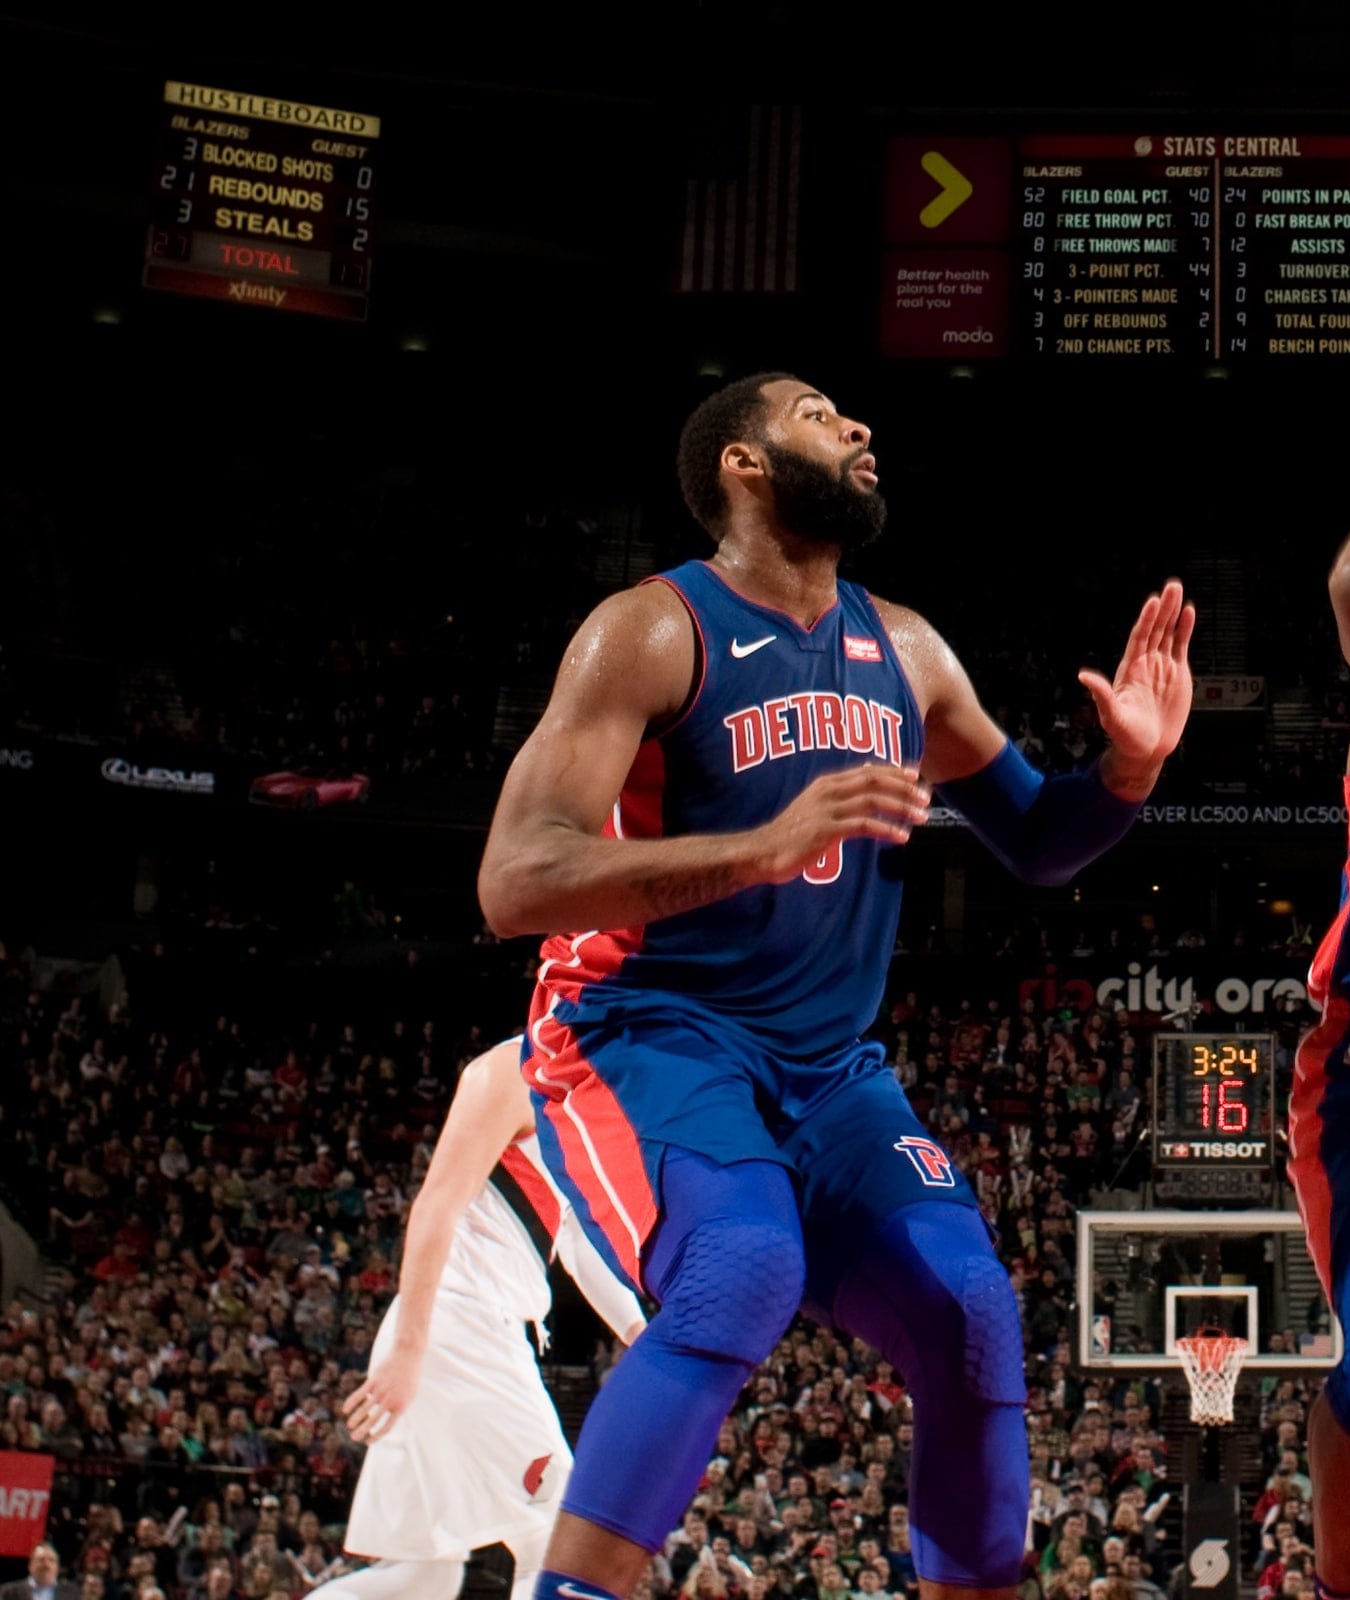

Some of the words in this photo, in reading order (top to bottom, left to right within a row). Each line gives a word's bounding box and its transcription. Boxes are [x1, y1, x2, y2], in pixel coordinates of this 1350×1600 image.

[180, 86, 366, 133] HUSTLEBOARD
[170, 114, 250, 141] BLAZERS
[311, 138, 369, 160] GUEST
[1163, 136, 1216, 157] STATS
[1224, 136, 1302, 157] CENTRAL
[183, 136, 198, 161] 3
[202, 142, 277, 173] BLOCKED
[281, 155, 334, 183] SHOTS
[356, 166, 372, 190] 0
[1023, 165, 1082, 178] BLAZERS
[1165, 165, 1210, 178] GUEST
[1224, 165, 1283, 178] BLAZERS
[160, 165, 196, 192] 21
[208, 174, 324, 213] REBOUNDS
[345, 197, 369, 221] 15
[1024, 186, 1046, 203] 52
[1061, 188, 1100, 204] FIELD
[1104, 188, 1139, 204] GOAL
[1142, 188, 1172, 204] PCT.
[1189, 187, 1210, 204] 40
[1224, 187, 1246, 203] 24
[1261, 188, 1311, 204] POINTS
[1314, 188, 1329, 204] IN
[177, 199, 192, 224] 3
[215, 207, 314, 242] STEALS
[352, 228, 368, 252] 2
[1023, 211, 1045, 228] 80
[1056, 213, 1091, 229] FREE
[1094, 213, 1143, 229] THROW
[1147, 213, 1176, 229] PCT.
[1190, 212, 1210, 228] 70
[1235, 211, 1246, 228] 0
[1255, 213, 1286, 229] FAST
[1289, 213, 1331, 229] BREAK
[1033, 236, 1045, 252] 8
[1053, 238, 1085, 254] FREE
[1088, 238, 1141, 254] THROWS
[1143, 238, 1179, 254] MADE
[1202, 237, 1210, 252] 7
[1231, 237, 1246, 252] 12
[1291, 238, 1346, 254] ASSISTS
[220, 243, 299, 275] TOTAL
[897, 268, 943, 280] Better
[945, 268, 990, 280] health
[1023, 262, 1044, 278] 30
[1134, 263, 1165, 279] PCT.
[1189, 262, 1210, 278] 44
[1237, 262, 1246, 278] 3
[228, 279, 287, 307] xfinity
[896, 282, 935, 296] plans
[937, 281, 957, 294] for
[960, 282, 983, 294] the
[1033, 288, 1044, 302] 4
[1141, 288, 1179, 304] MADE
[1199, 288, 1210, 302] 4
[1235, 286, 1246, 303] 0
[1264, 288, 1328, 304] CHARGES
[896, 296, 924, 309] real
[926, 298, 951, 311] you
[1033, 312, 1044, 328] 3
[1063, 313, 1090, 328] OFF
[1094, 313, 1168, 328] REBOUNDS
[1199, 312, 1210, 328] 2
[1236, 312, 1246, 327] 9
[1275, 313, 1315, 329] TOTAL
[942, 324, 994, 343] moda
[1034, 337, 1044, 352] 7
[1056, 338, 1083, 354] 2ND
[1087, 338, 1142, 354] CHANCE
[1145, 338, 1175, 354] PTS.
[1231, 337, 1246, 352] 14
[1269, 338, 1315, 354] BENCH
[723, 692, 903, 773] DETROIT
[133, 765, 216, 787] LEXUS
[1190, 806, 1249, 824] LC500
[1252, 806, 1291, 824] AND
[1096, 961, 1194, 1014] city
[1215, 977, 1324, 1014] ore
[1194, 1046, 1257, 1076] 3:24
[1202, 1080, 1248, 1132] 16
[1190, 1143, 1267, 1158] TISSOT
